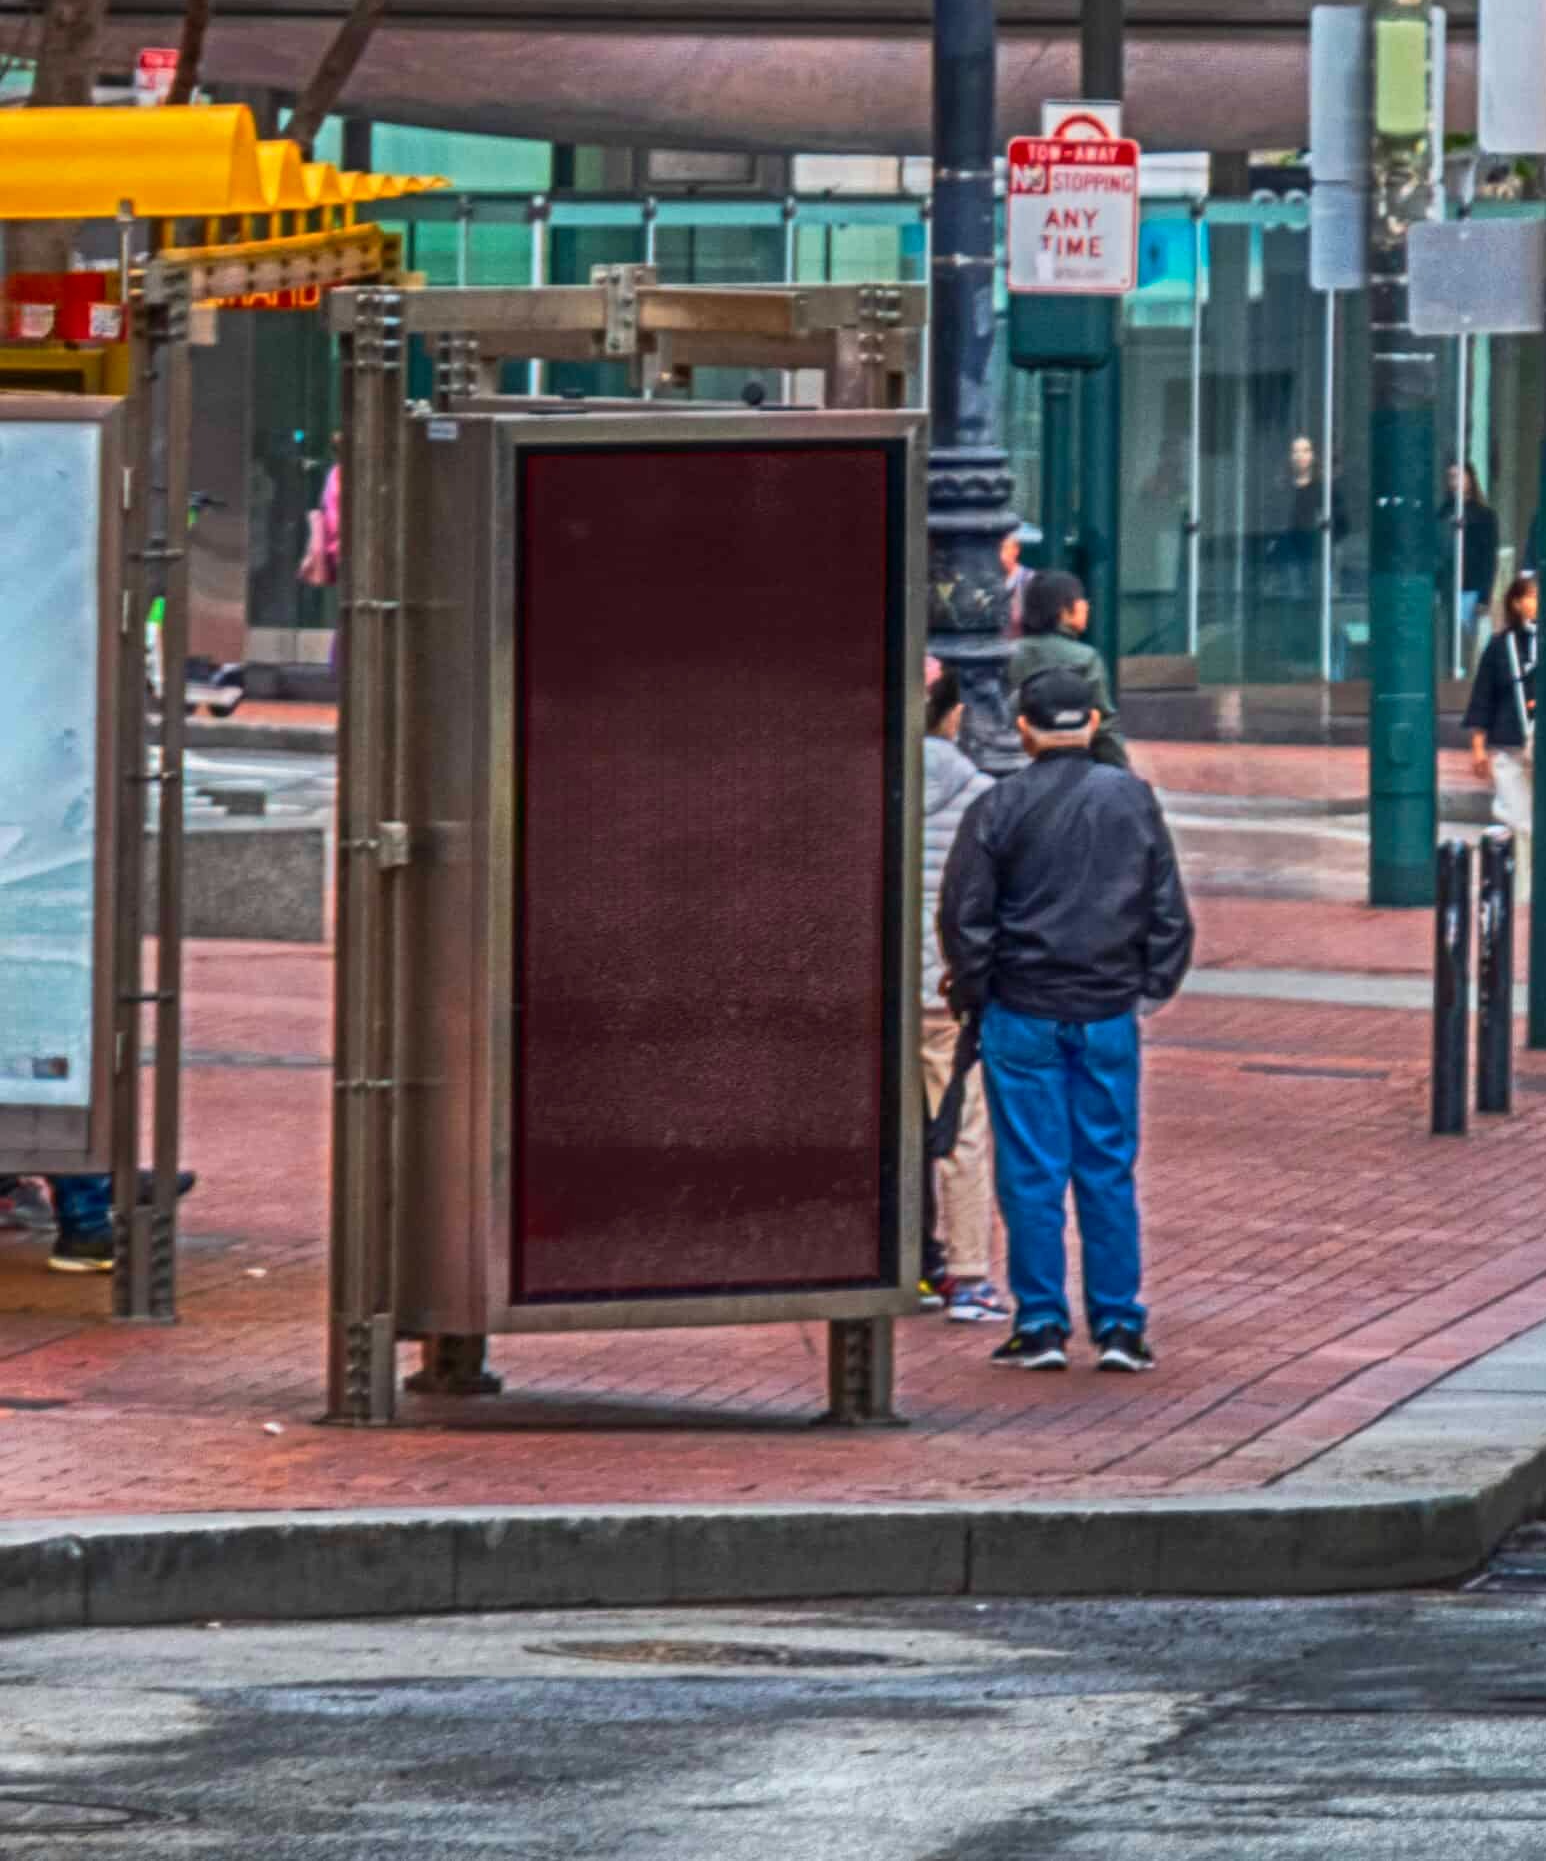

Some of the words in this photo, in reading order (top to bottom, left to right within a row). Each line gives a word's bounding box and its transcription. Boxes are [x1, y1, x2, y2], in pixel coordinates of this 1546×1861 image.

[1028, 144, 1119, 162] TOW-AWAY
[1011, 165, 1047, 193] NO
[1053, 172, 1134, 193] STOPPING
[1044, 207, 1099, 228] ANY
[1039, 234, 1103, 257] TIME
